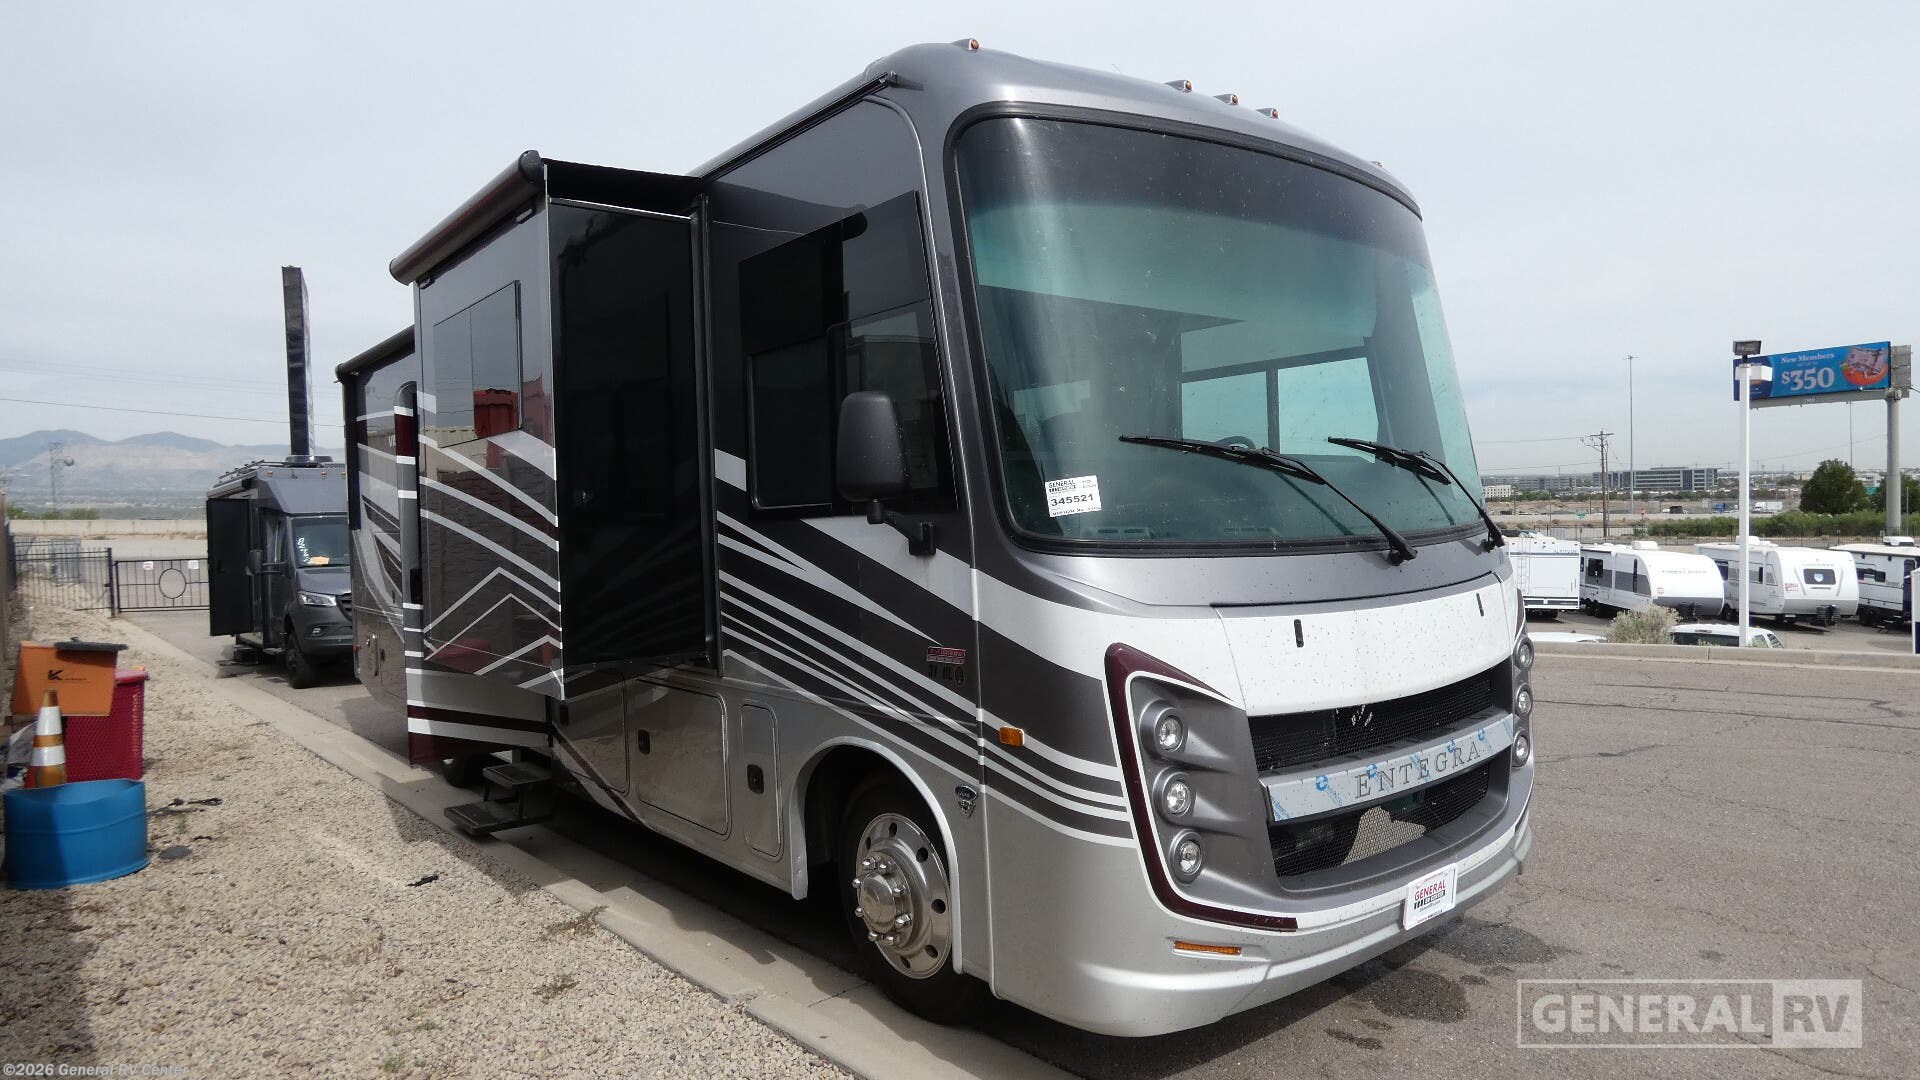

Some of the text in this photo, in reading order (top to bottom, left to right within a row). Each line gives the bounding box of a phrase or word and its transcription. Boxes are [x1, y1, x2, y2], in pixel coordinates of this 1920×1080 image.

[1798, 353, 1835, 362] Members
[1782, 367, 1835, 391] $350
[1048, 479, 1076, 489] GENERAL
[1050, 493, 1094, 507] 345521
[1354, 741, 1481, 799] ENTEGRA
[1414, 881, 1446, 901] GENERAL
